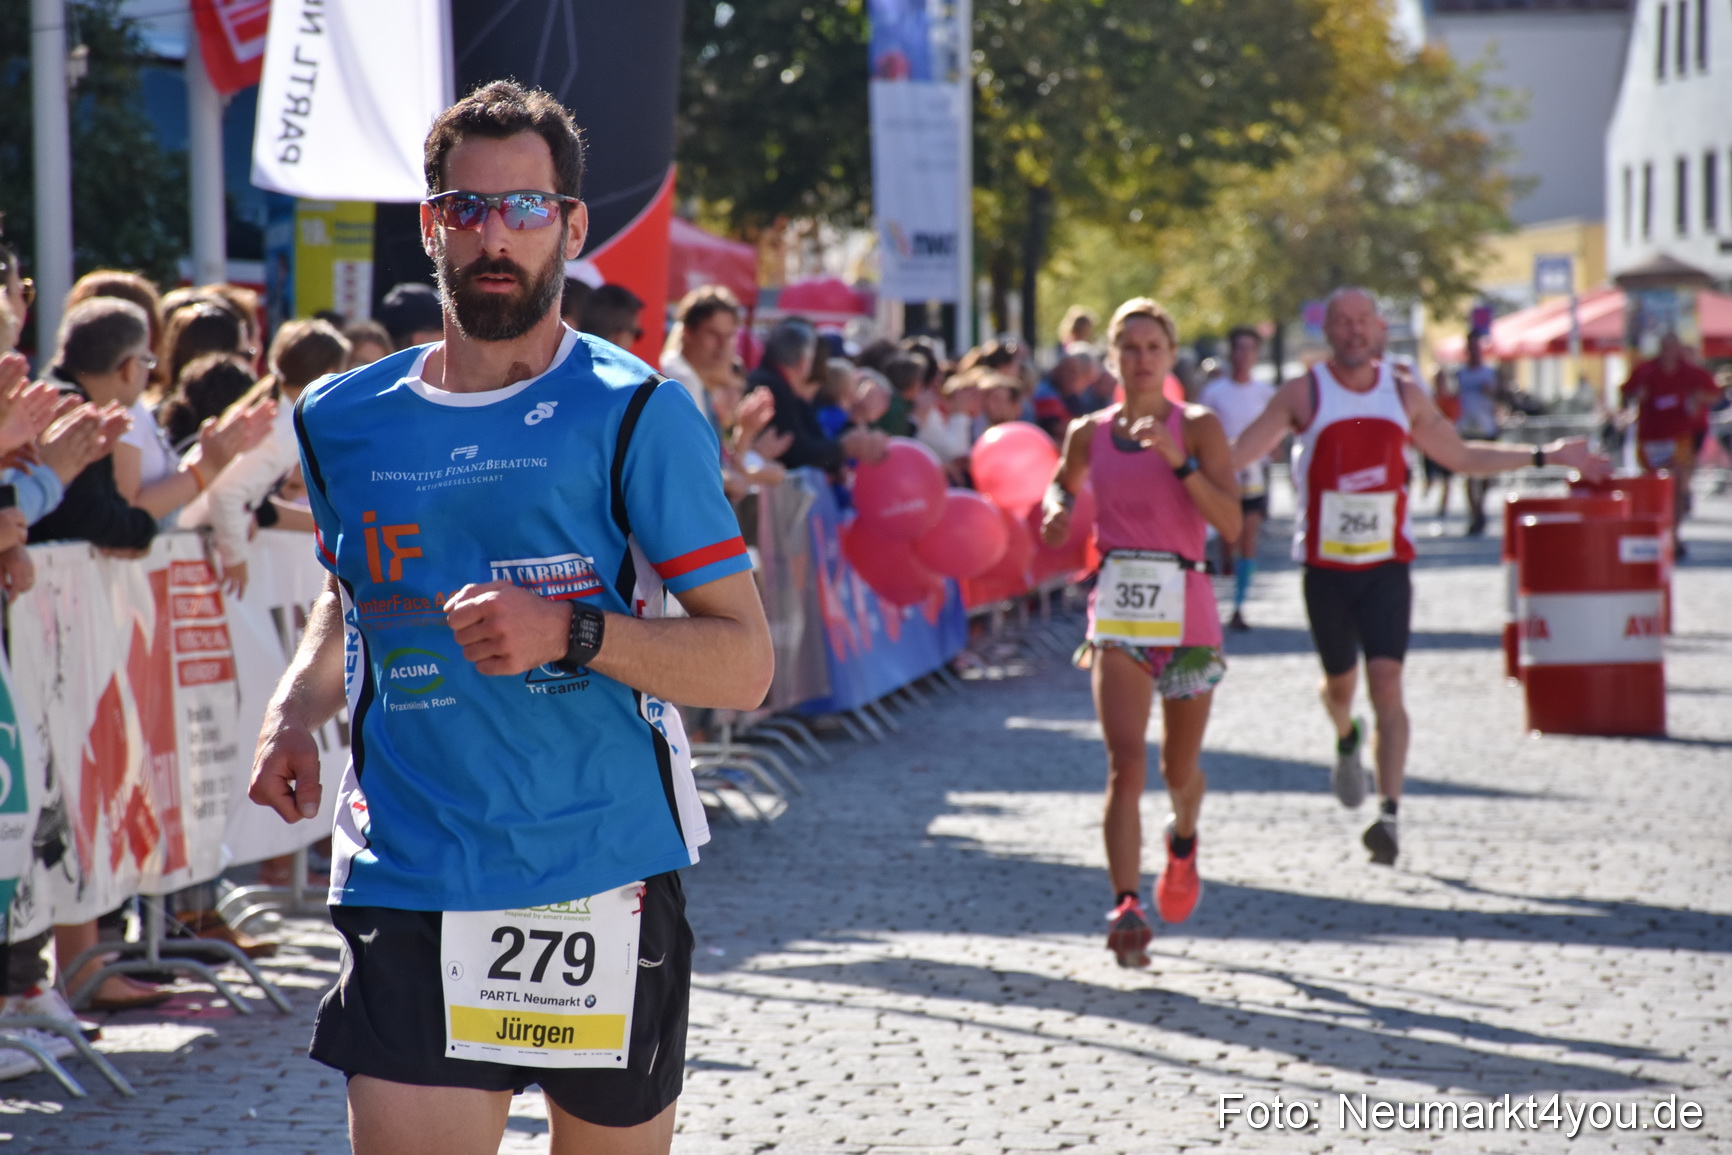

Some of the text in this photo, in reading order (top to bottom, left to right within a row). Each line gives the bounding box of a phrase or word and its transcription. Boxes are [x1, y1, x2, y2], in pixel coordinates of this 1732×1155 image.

[1115, 583, 1161, 609] 357
[390, 663, 440, 680] ACUNA
[431, 696, 457, 708] Roth
[504, 909, 532, 919] inspired
[533, 912, 541, 920] by
[543, 913, 563, 921] smart
[487, 925, 596, 987] 279
[451, 965, 459, 977] A
[480, 989, 581, 1007] PARTL Neumarkt
[496, 1016, 575, 1048] Jürgen
